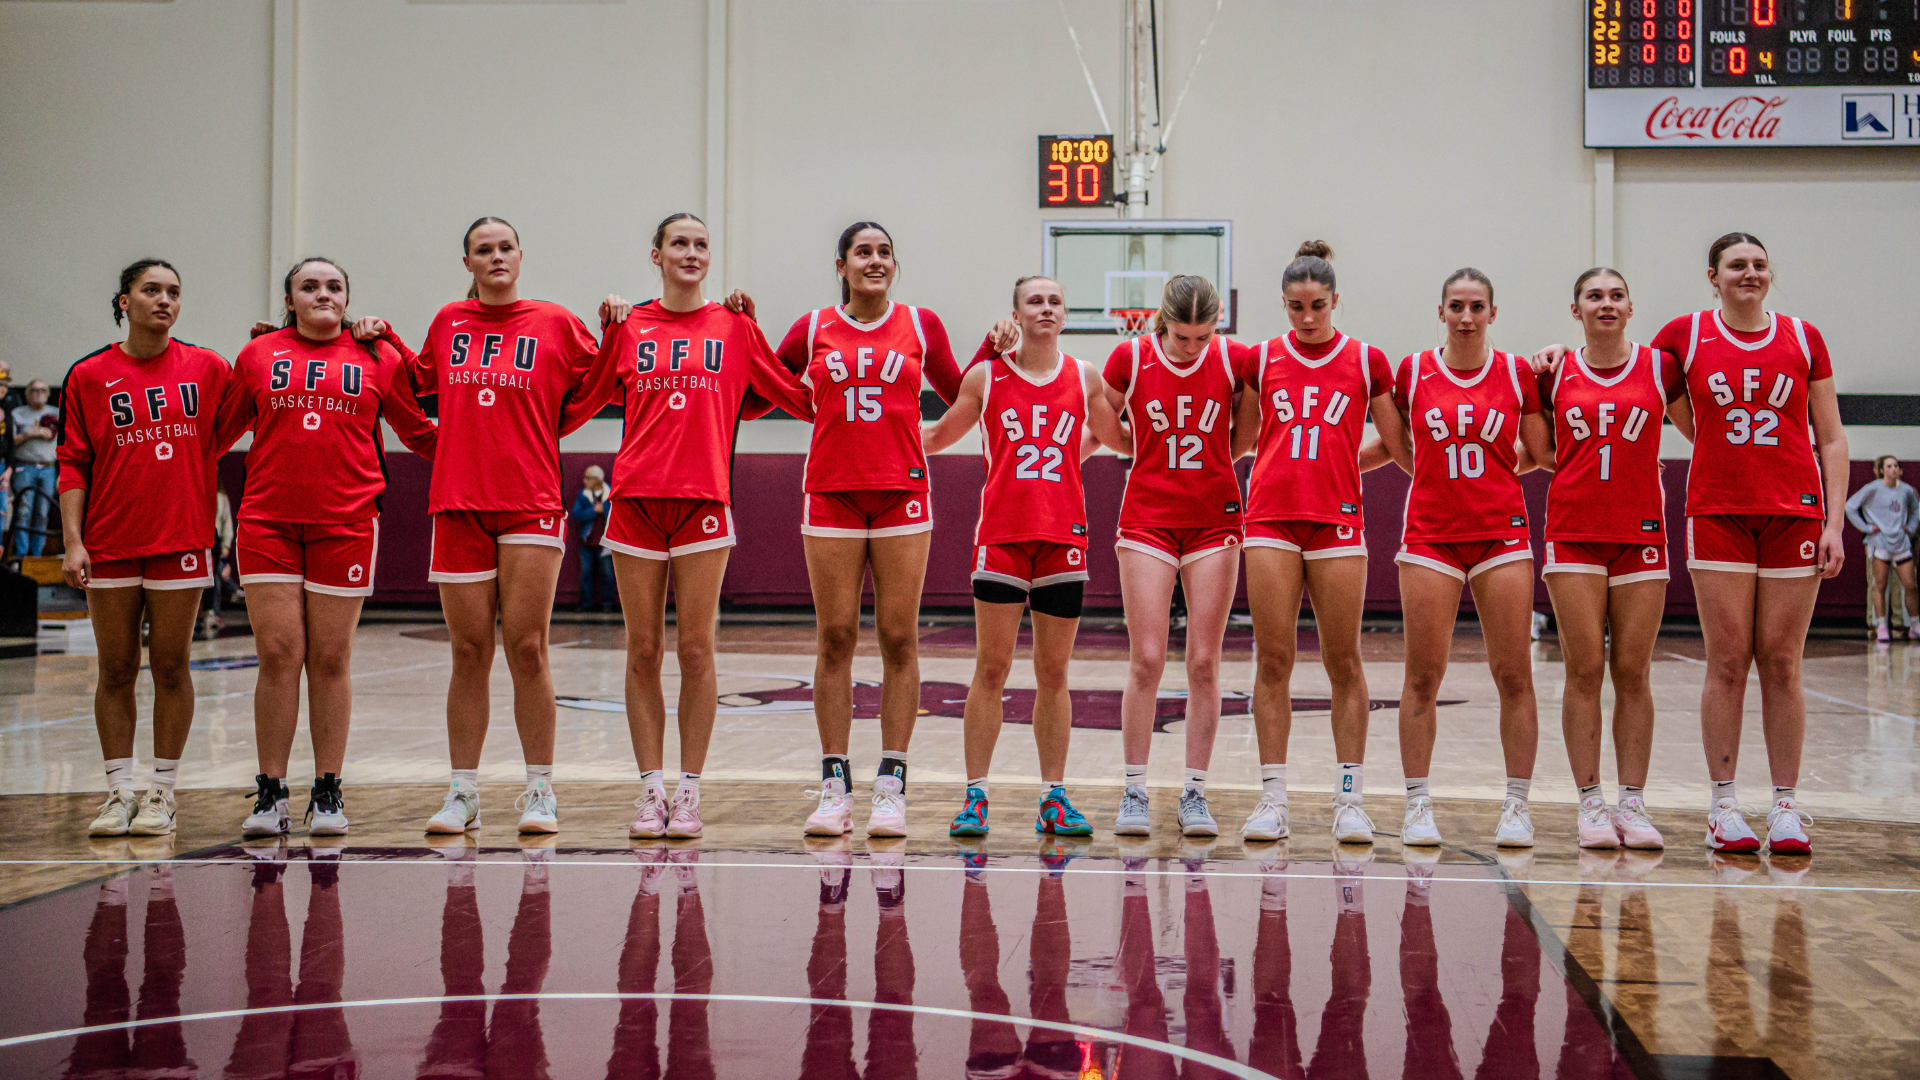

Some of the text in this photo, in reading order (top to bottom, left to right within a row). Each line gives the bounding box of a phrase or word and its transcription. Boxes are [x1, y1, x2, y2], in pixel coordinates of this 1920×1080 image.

[1593, 0, 1691, 18] 21 0 0
[1593, 19, 1691, 41] 22 0 0
[1710, 29, 1892, 43] FOULS PLYR FOUL PTS
[1594, 43, 1691, 65] 32 0 0
[1729, 47, 1746, 74] 0
[1759, 51, 1772, 69] 4
[1645, 96, 1789, 140] Coca-Cola
[1051, 140, 1108, 163] 10:00
[1048, 164, 1099, 203] 30
[449, 332, 538, 372] SFU
[636, 338, 724, 374] SFU
[824, 346, 905, 384] SFU
[270, 359, 363, 397] SFU
[448, 371, 531, 391] BASKETBALL
[637, 375, 719, 393] BASKETBALL
[1706, 367, 1795, 409] SFU
[109, 382, 199, 428] SFU
[270, 396, 358, 416] BASKETBALL
[843, 386, 883, 422] 15
[1145, 394, 1222, 434] SFU
[1272, 385, 1351, 426] SFU
[1565, 402, 1650, 443] SFU
[116, 424, 198, 447] BASKETBALL
[1000, 404, 1076, 446] SFU
[1290, 424, 1320, 460] 11
[1424, 403, 1506, 444] SFU
[1725, 407, 1779, 447] 32
[1015, 443, 1064, 483] 22
[1165, 434, 1204, 470] 12
[1444, 442, 1485, 480] 10
[1598, 444, 1611, 481] 1
